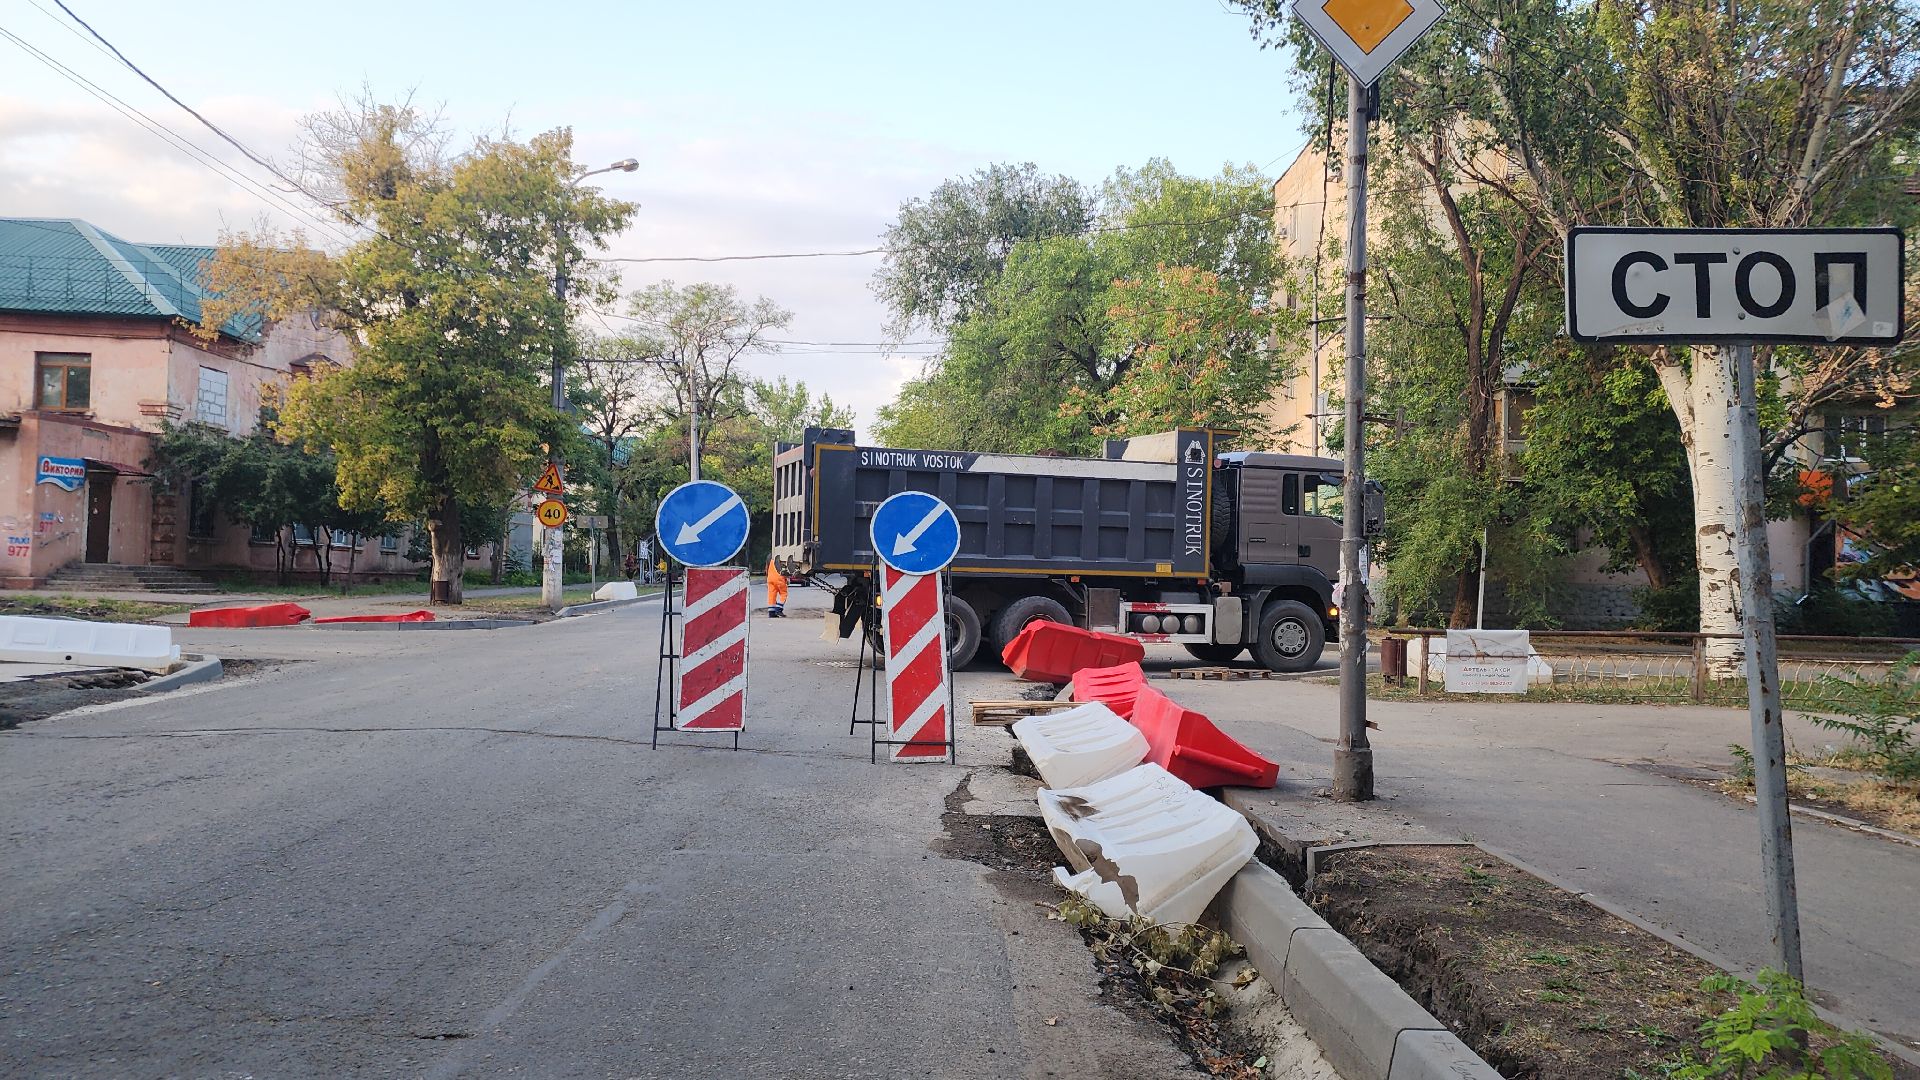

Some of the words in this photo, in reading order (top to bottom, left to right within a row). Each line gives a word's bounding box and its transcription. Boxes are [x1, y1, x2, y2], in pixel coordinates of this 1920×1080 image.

[1611, 250, 1867, 319] СТОП
[860, 451, 917, 468] SINOTRUK
[922, 454, 964, 471] VOSTOK
[544, 508, 561, 520] 40
[1185, 467, 1204, 557] SINOTRUK
[8, 536, 30, 544] TAXI
[8, 545, 30, 557] 977
